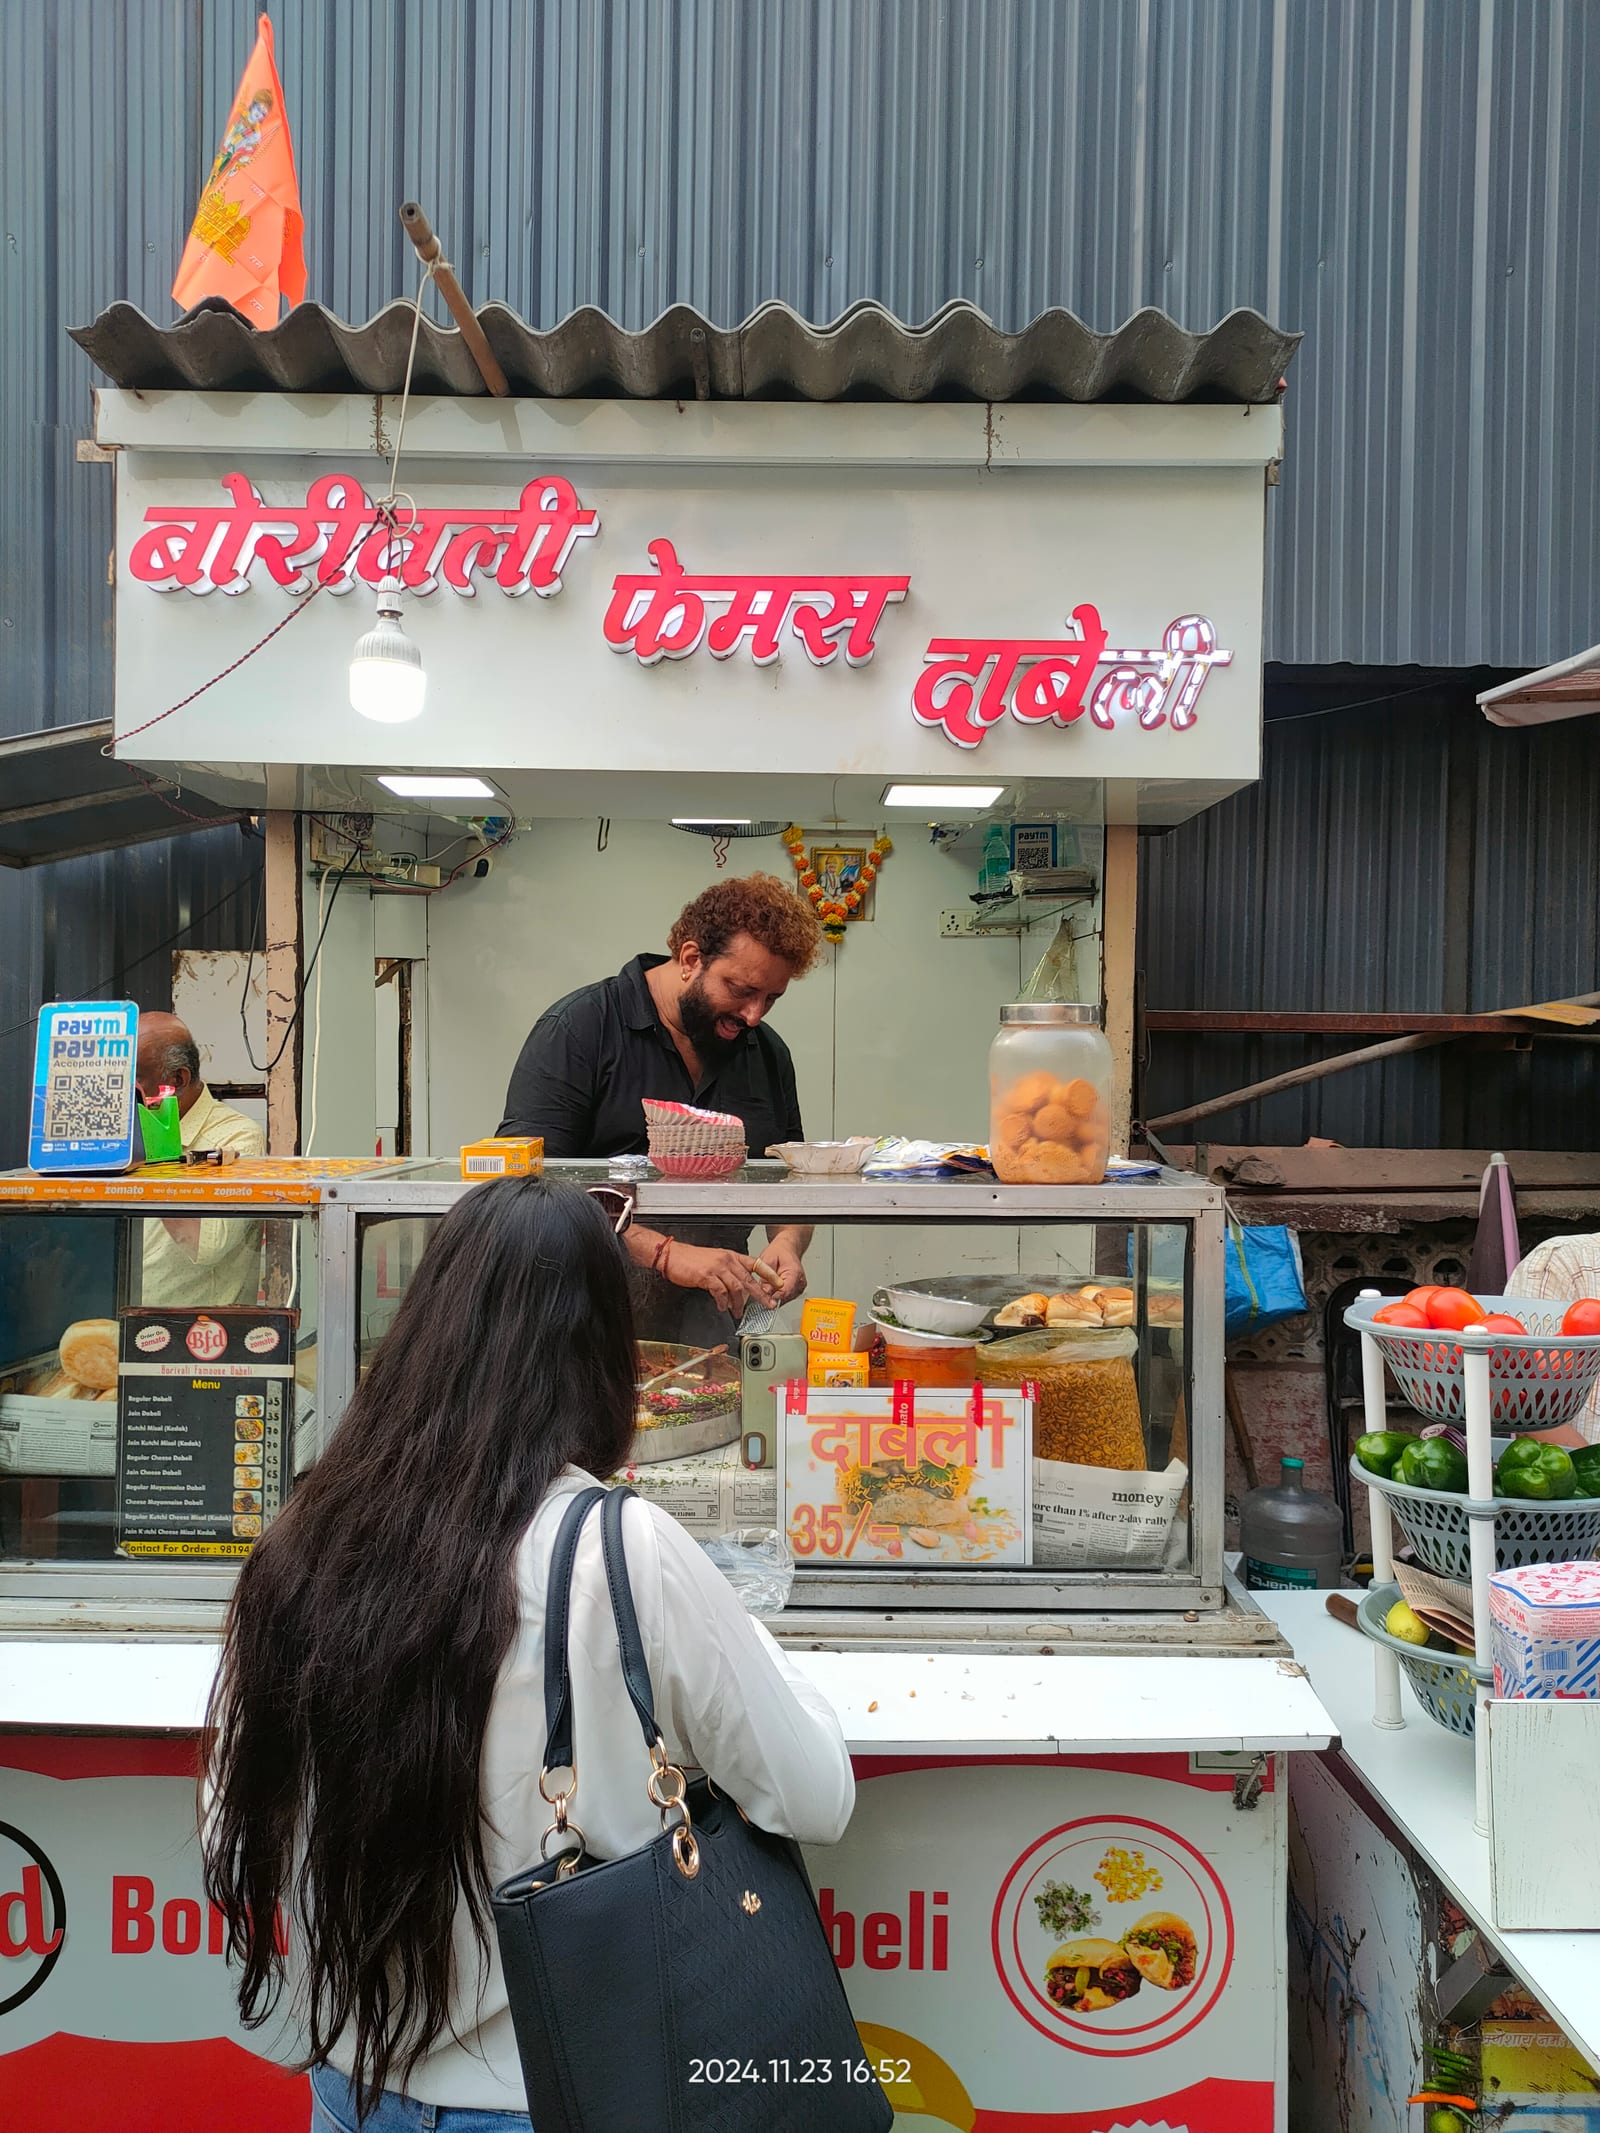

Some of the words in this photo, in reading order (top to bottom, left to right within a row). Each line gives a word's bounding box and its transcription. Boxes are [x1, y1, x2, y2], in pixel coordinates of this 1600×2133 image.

[129, 472, 599, 596] बोरीवली
[602, 538, 911, 666] फेमस
[911, 604, 1234, 748] दाबेली
[54, 1059, 101, 1068] Accepted
[104, 1059, 127, 1067] Here
[105, 1184, 144, 1195] zomato
[214, 1186, 252, 1196] zomato
[141, 1336, 166, 1348] zomato
[187, 1329, 225, 1354] Bfd
[192, 1379, 220, 1390] Menu
[806, 1397, 1014, 1472] दाबली
[1112, 1491, 1164, 1507] money
[1053, 1505, 1076, 1516] than
[1079, 1508, 1090, 1518] 1%
[1092, 1510, 1117, 1522] after
[1118, 1514, 1142, 1526] 2-day
[1145, 1517, 1169, 1528] rally
[791, 1501, 899, 1558] 35/-
[163, 1543, 178, 1553] For
[181, 1544, 209, 1553] Order
[220, 1544, 250, 1554] 98194
